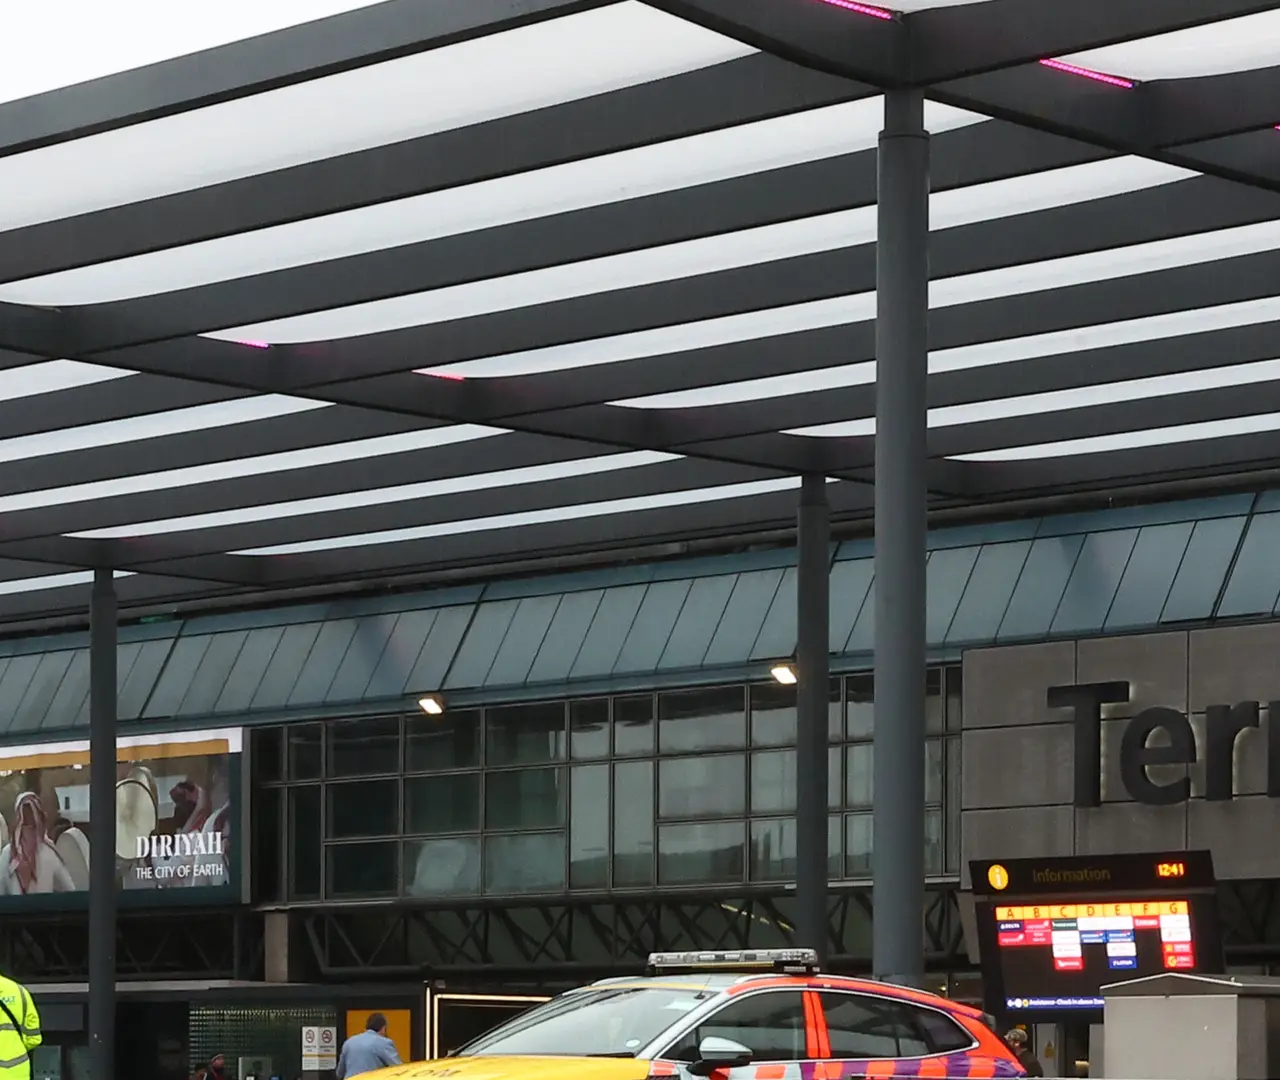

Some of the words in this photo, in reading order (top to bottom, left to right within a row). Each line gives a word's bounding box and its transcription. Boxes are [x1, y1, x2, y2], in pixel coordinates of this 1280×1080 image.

[136, 831, 222, 858] DIRIYAH
[136, 866, 153, 879] THE
[154, 866, 175, 879] CITY
[177, 865, 191, 878] OF
[193, 863, 223, 877] EARTH
[1033, 867, 1111, 883] Information
[1006, 908, 1015, 918] A
[1033, 907, 1041, 918] B
[1059, 906, 1067, 917] C
[1086, 905, 1095, 916] D
[1114, 904, 1121, 916] E
[1169, 902, 1178, 914] G
